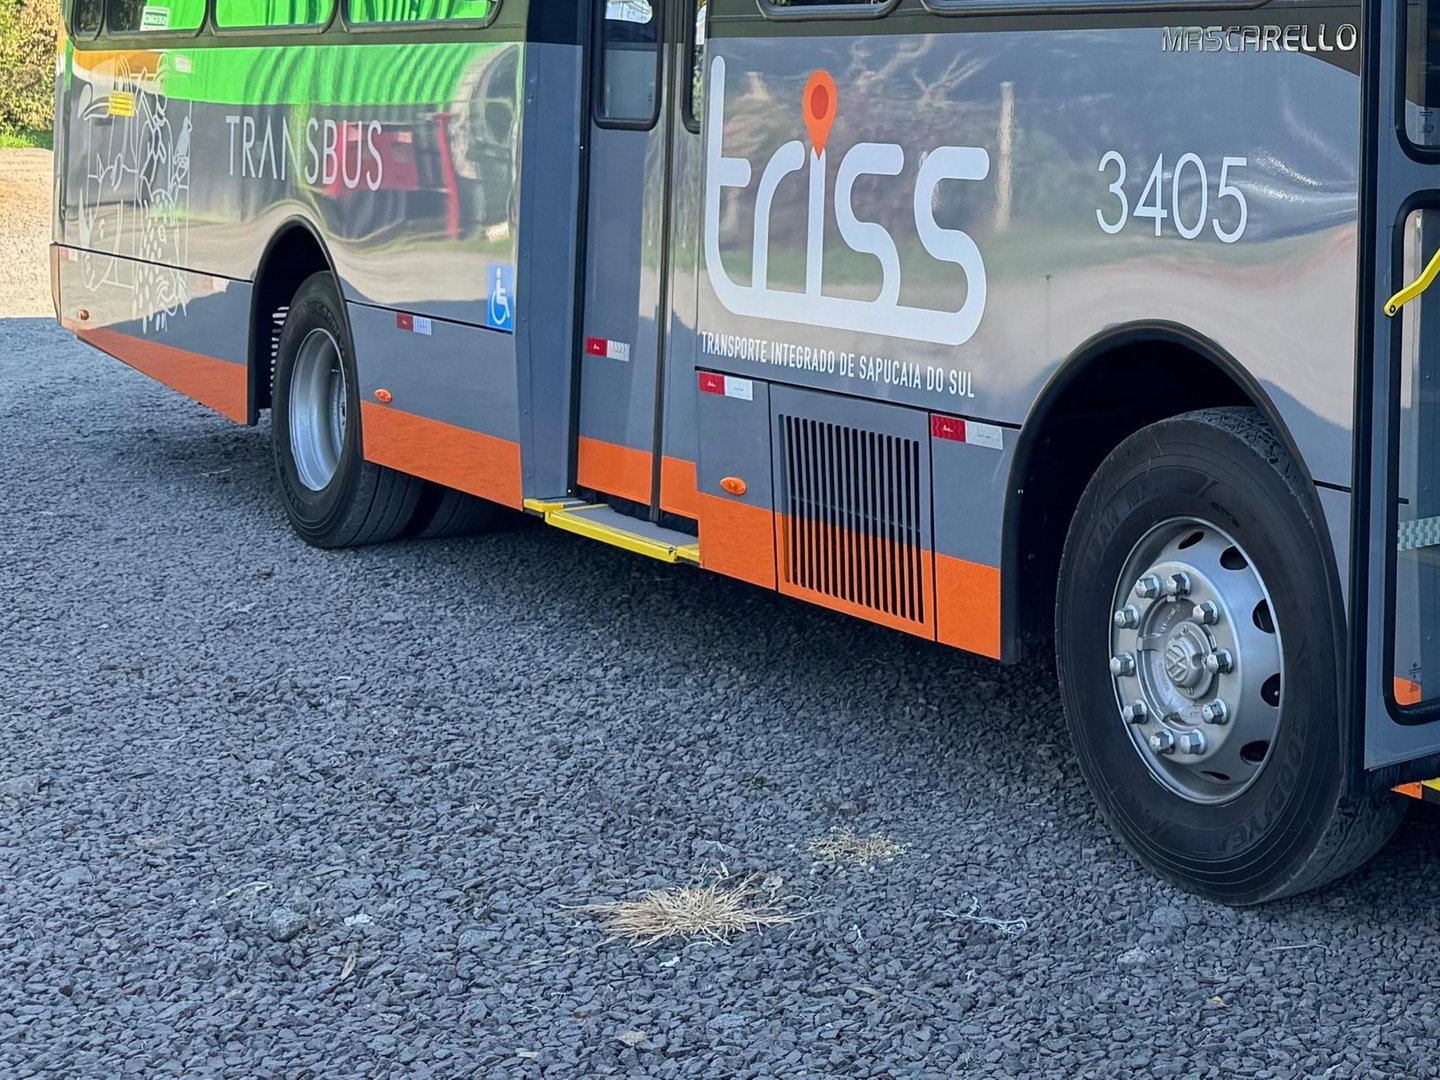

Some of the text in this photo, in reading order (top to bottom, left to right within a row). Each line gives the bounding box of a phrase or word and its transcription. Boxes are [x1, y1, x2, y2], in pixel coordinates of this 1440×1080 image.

[1161, 23, 1358, 53] MASCARELLO
[225, 113, 384, 192] TRANSBUS
[704, 55, 990, 346] triss
[1095, 149, 1249, 245] 3405
[701, 331, 975, 398] TRANSPORTE INTEGRADO DE SAPUCAIA DO SUL
